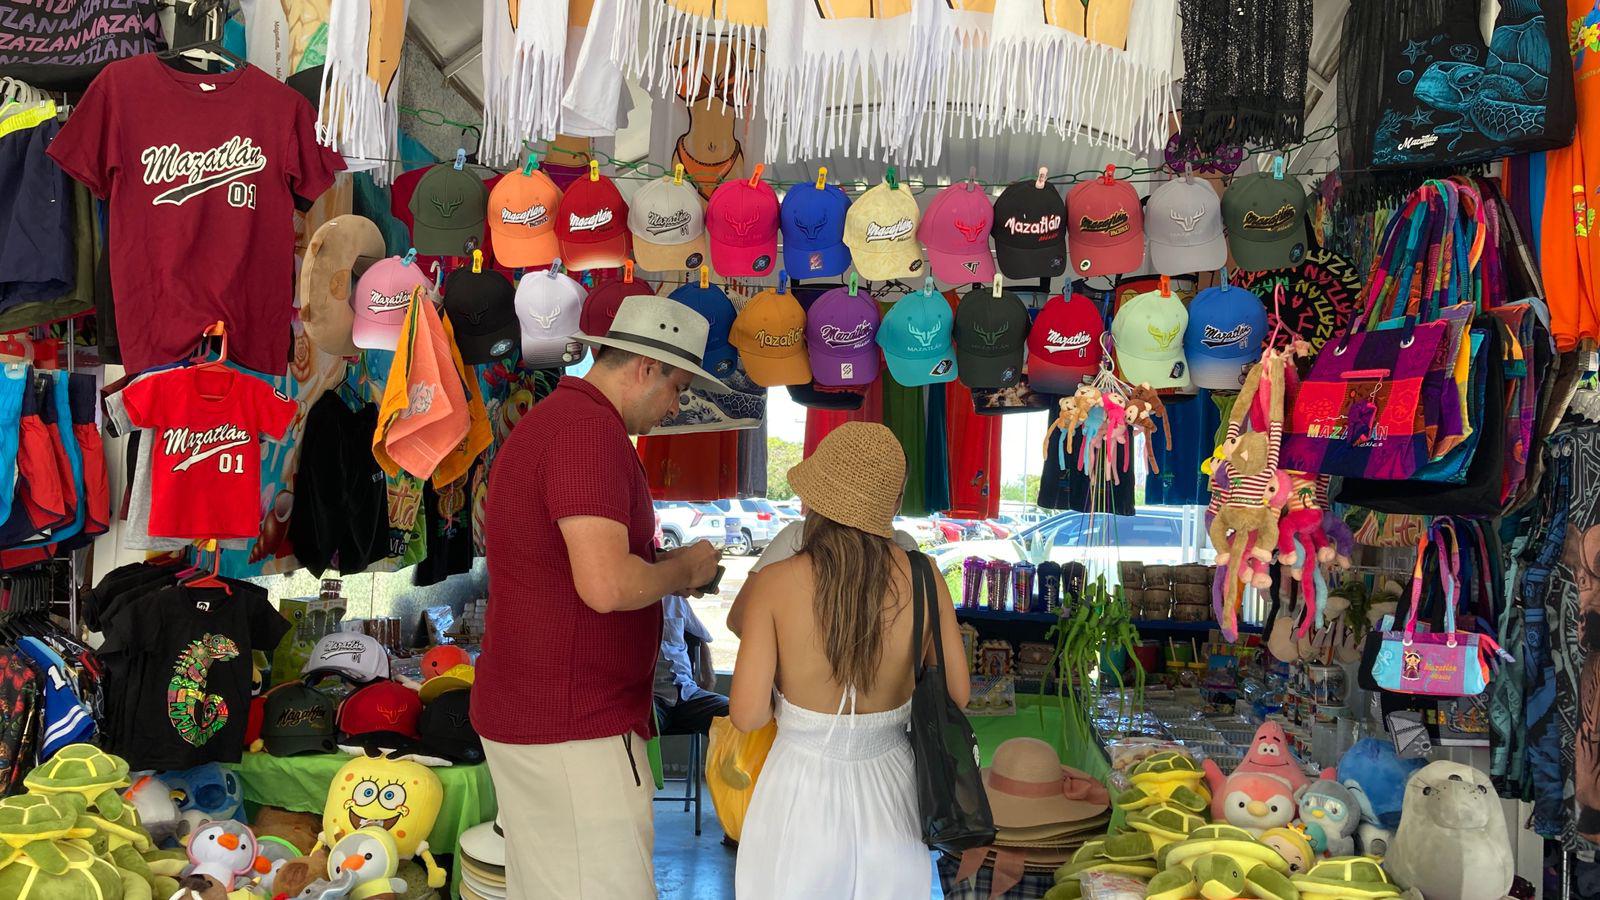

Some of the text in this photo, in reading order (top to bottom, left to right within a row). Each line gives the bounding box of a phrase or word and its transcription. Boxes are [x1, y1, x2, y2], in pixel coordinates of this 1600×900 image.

[141, 136, 263, 185] Mazatlán
[228, 181, 256, 209] 01
[163, 423, 248, 456] Mazatlán
[219, 453, 244, 474] 01
